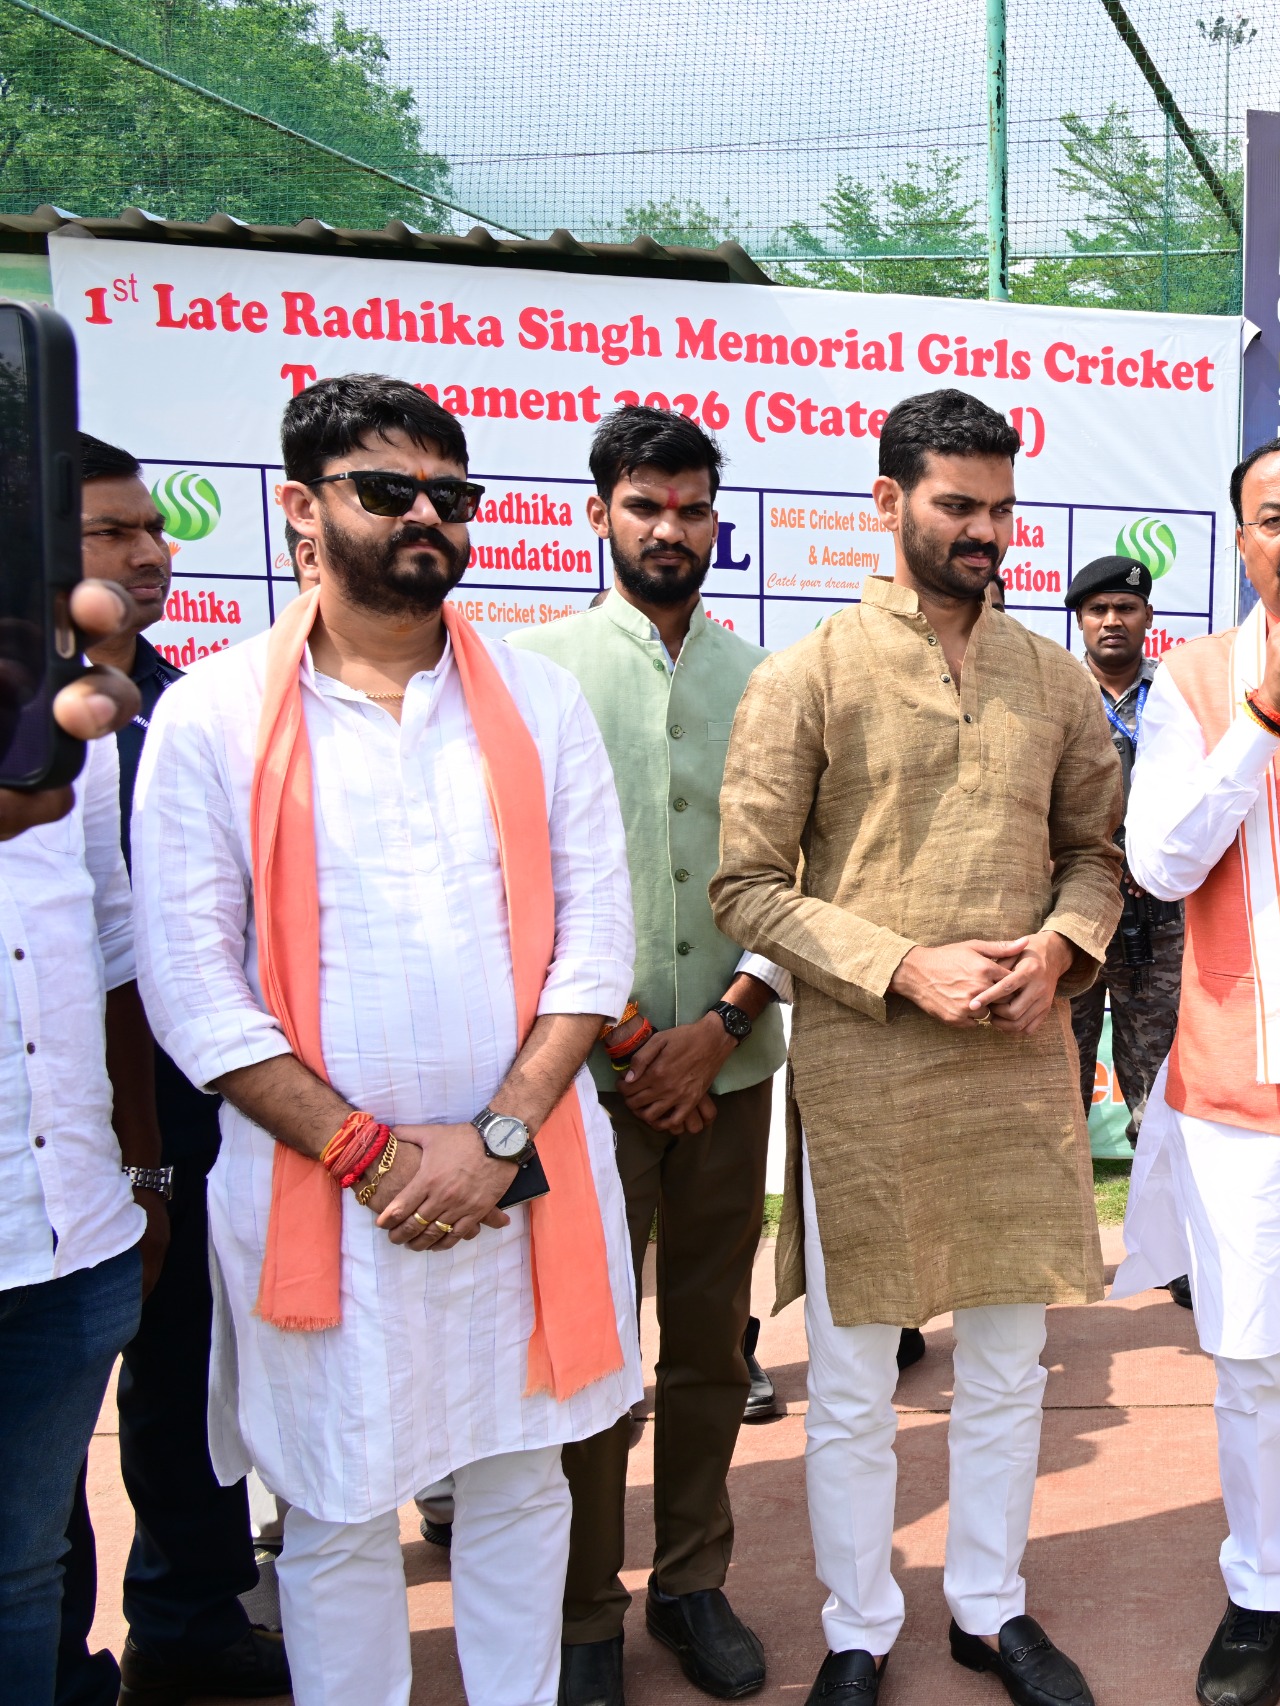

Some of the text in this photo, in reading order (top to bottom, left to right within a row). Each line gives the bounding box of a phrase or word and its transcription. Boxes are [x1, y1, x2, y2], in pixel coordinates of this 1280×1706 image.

[85, 273, 1215, 393] 1st Late Radhika Singh Memorial Girls Cricket
[770, 507, 806, 529] SAGE
[809, 509, 855, 532] Cricket
[808, 545, 880, 573] & Academy
[766, 573, 860, 590] Catch your dreams
[161, 589, 242, 625] dhika
[487, 601, 536, 624] Cricket
